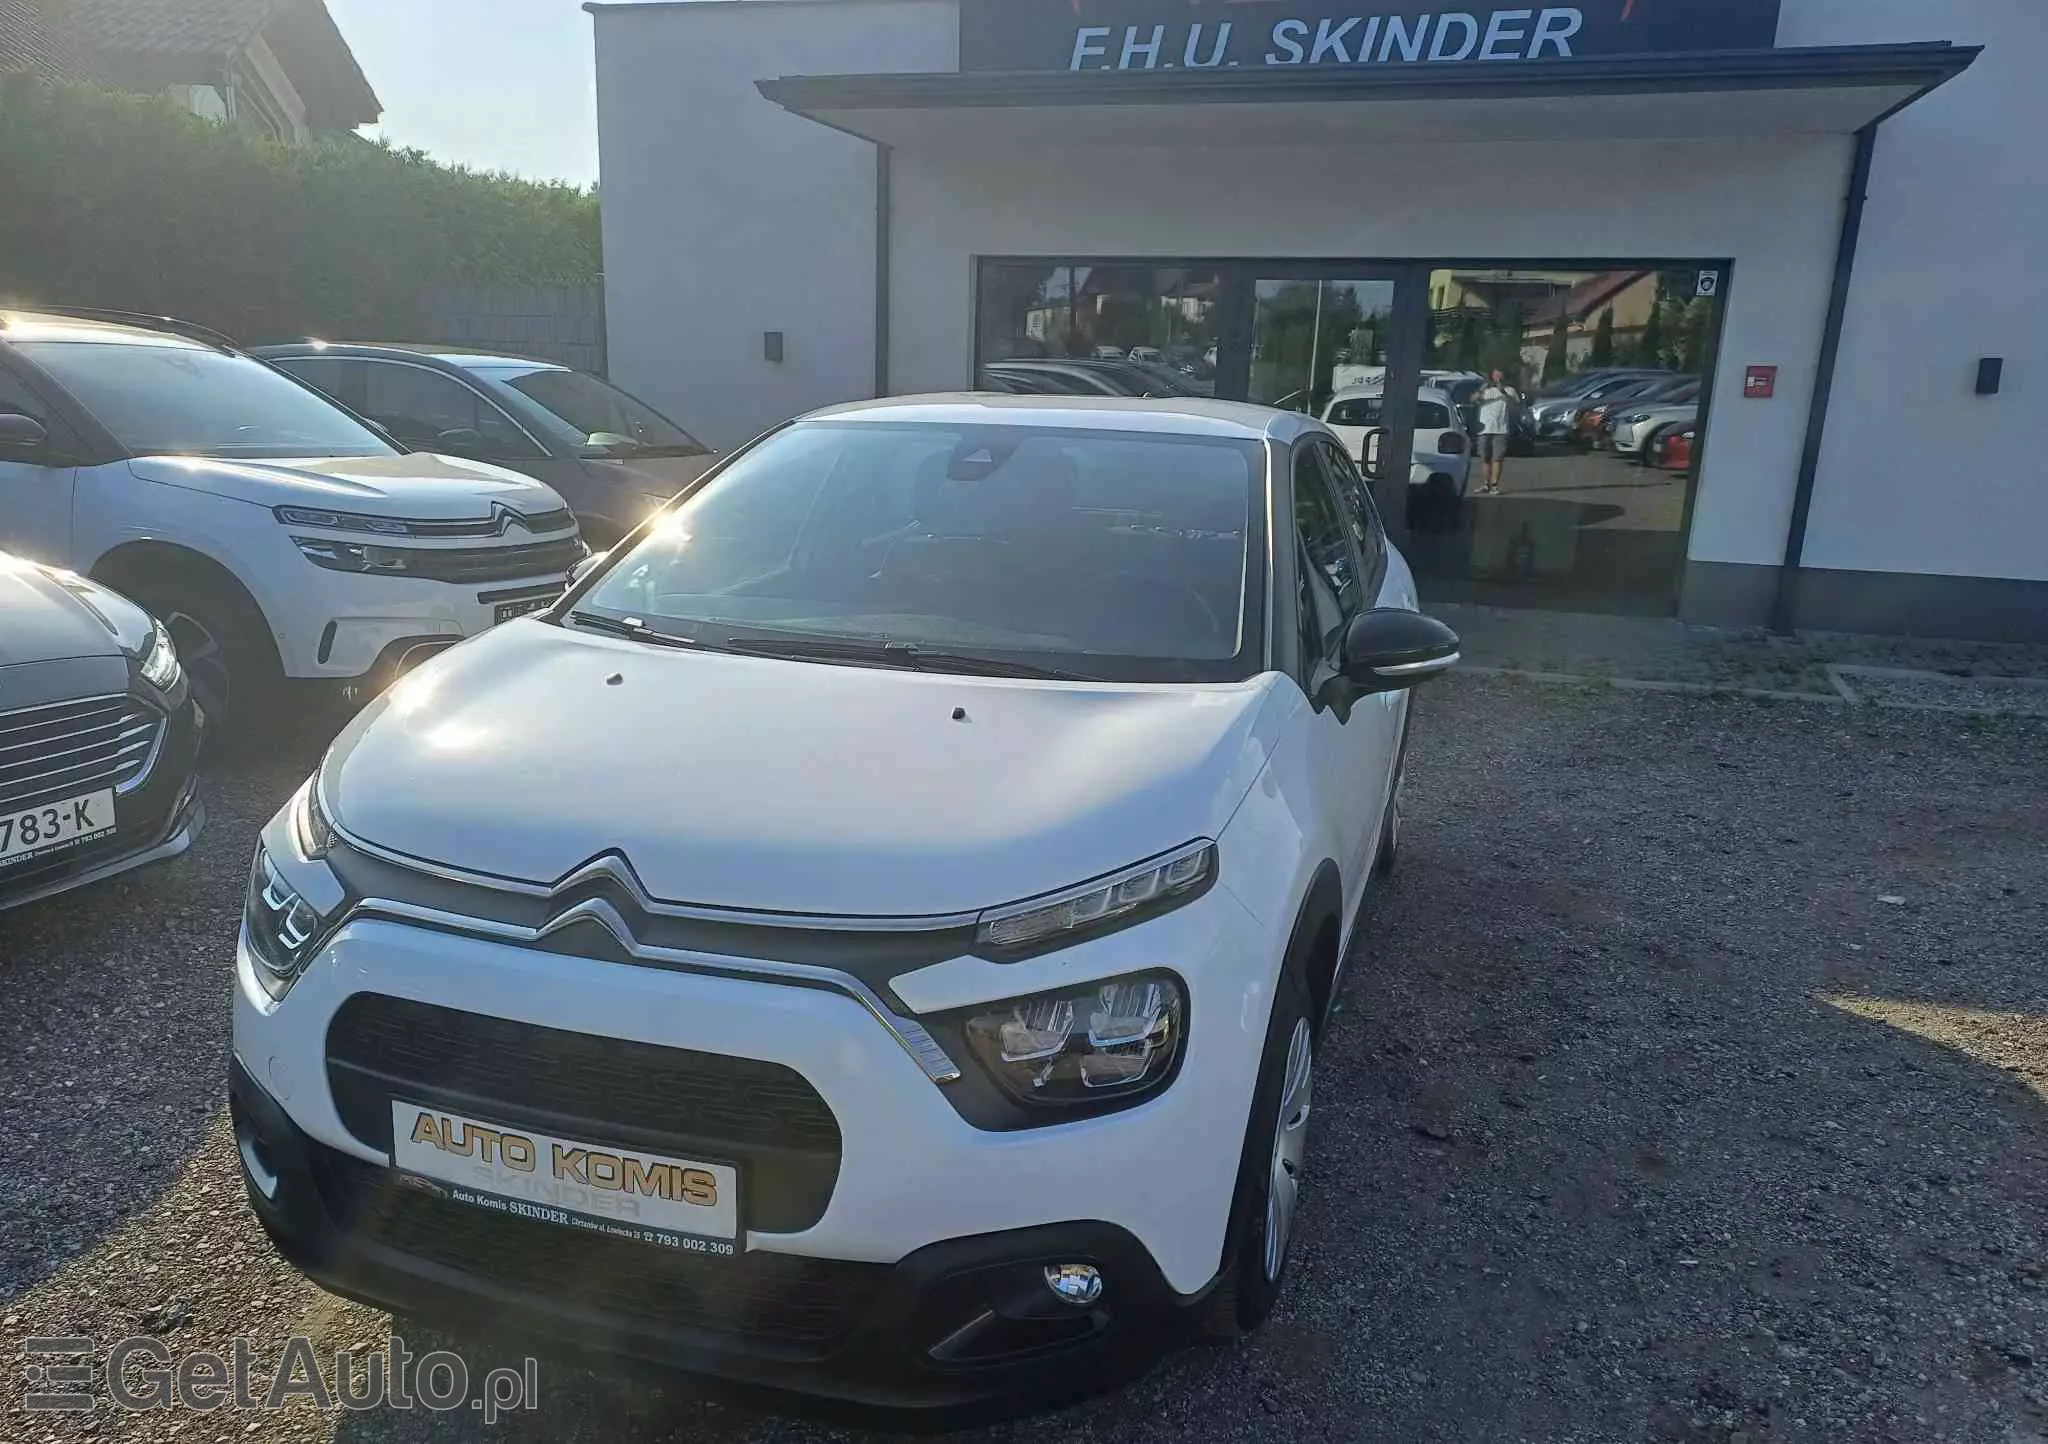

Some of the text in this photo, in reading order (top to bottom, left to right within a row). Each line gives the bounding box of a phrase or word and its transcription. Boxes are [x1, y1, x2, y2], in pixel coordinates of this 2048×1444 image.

[1069, 7, 1583, 71] F.H.U. SKINDER
[410, 1111, 719, 1207] AUTO KOMIS
[453, 1189, 474, 1203] Auto
[476, 1195, 507, 1210] Komis
[509, 1201, 569, 1225] SKINDER
[656, 1233, 679, 1247] 793
[682, 1238, 706, 1252] 002
[709, 1242, 734, 1255] 309
